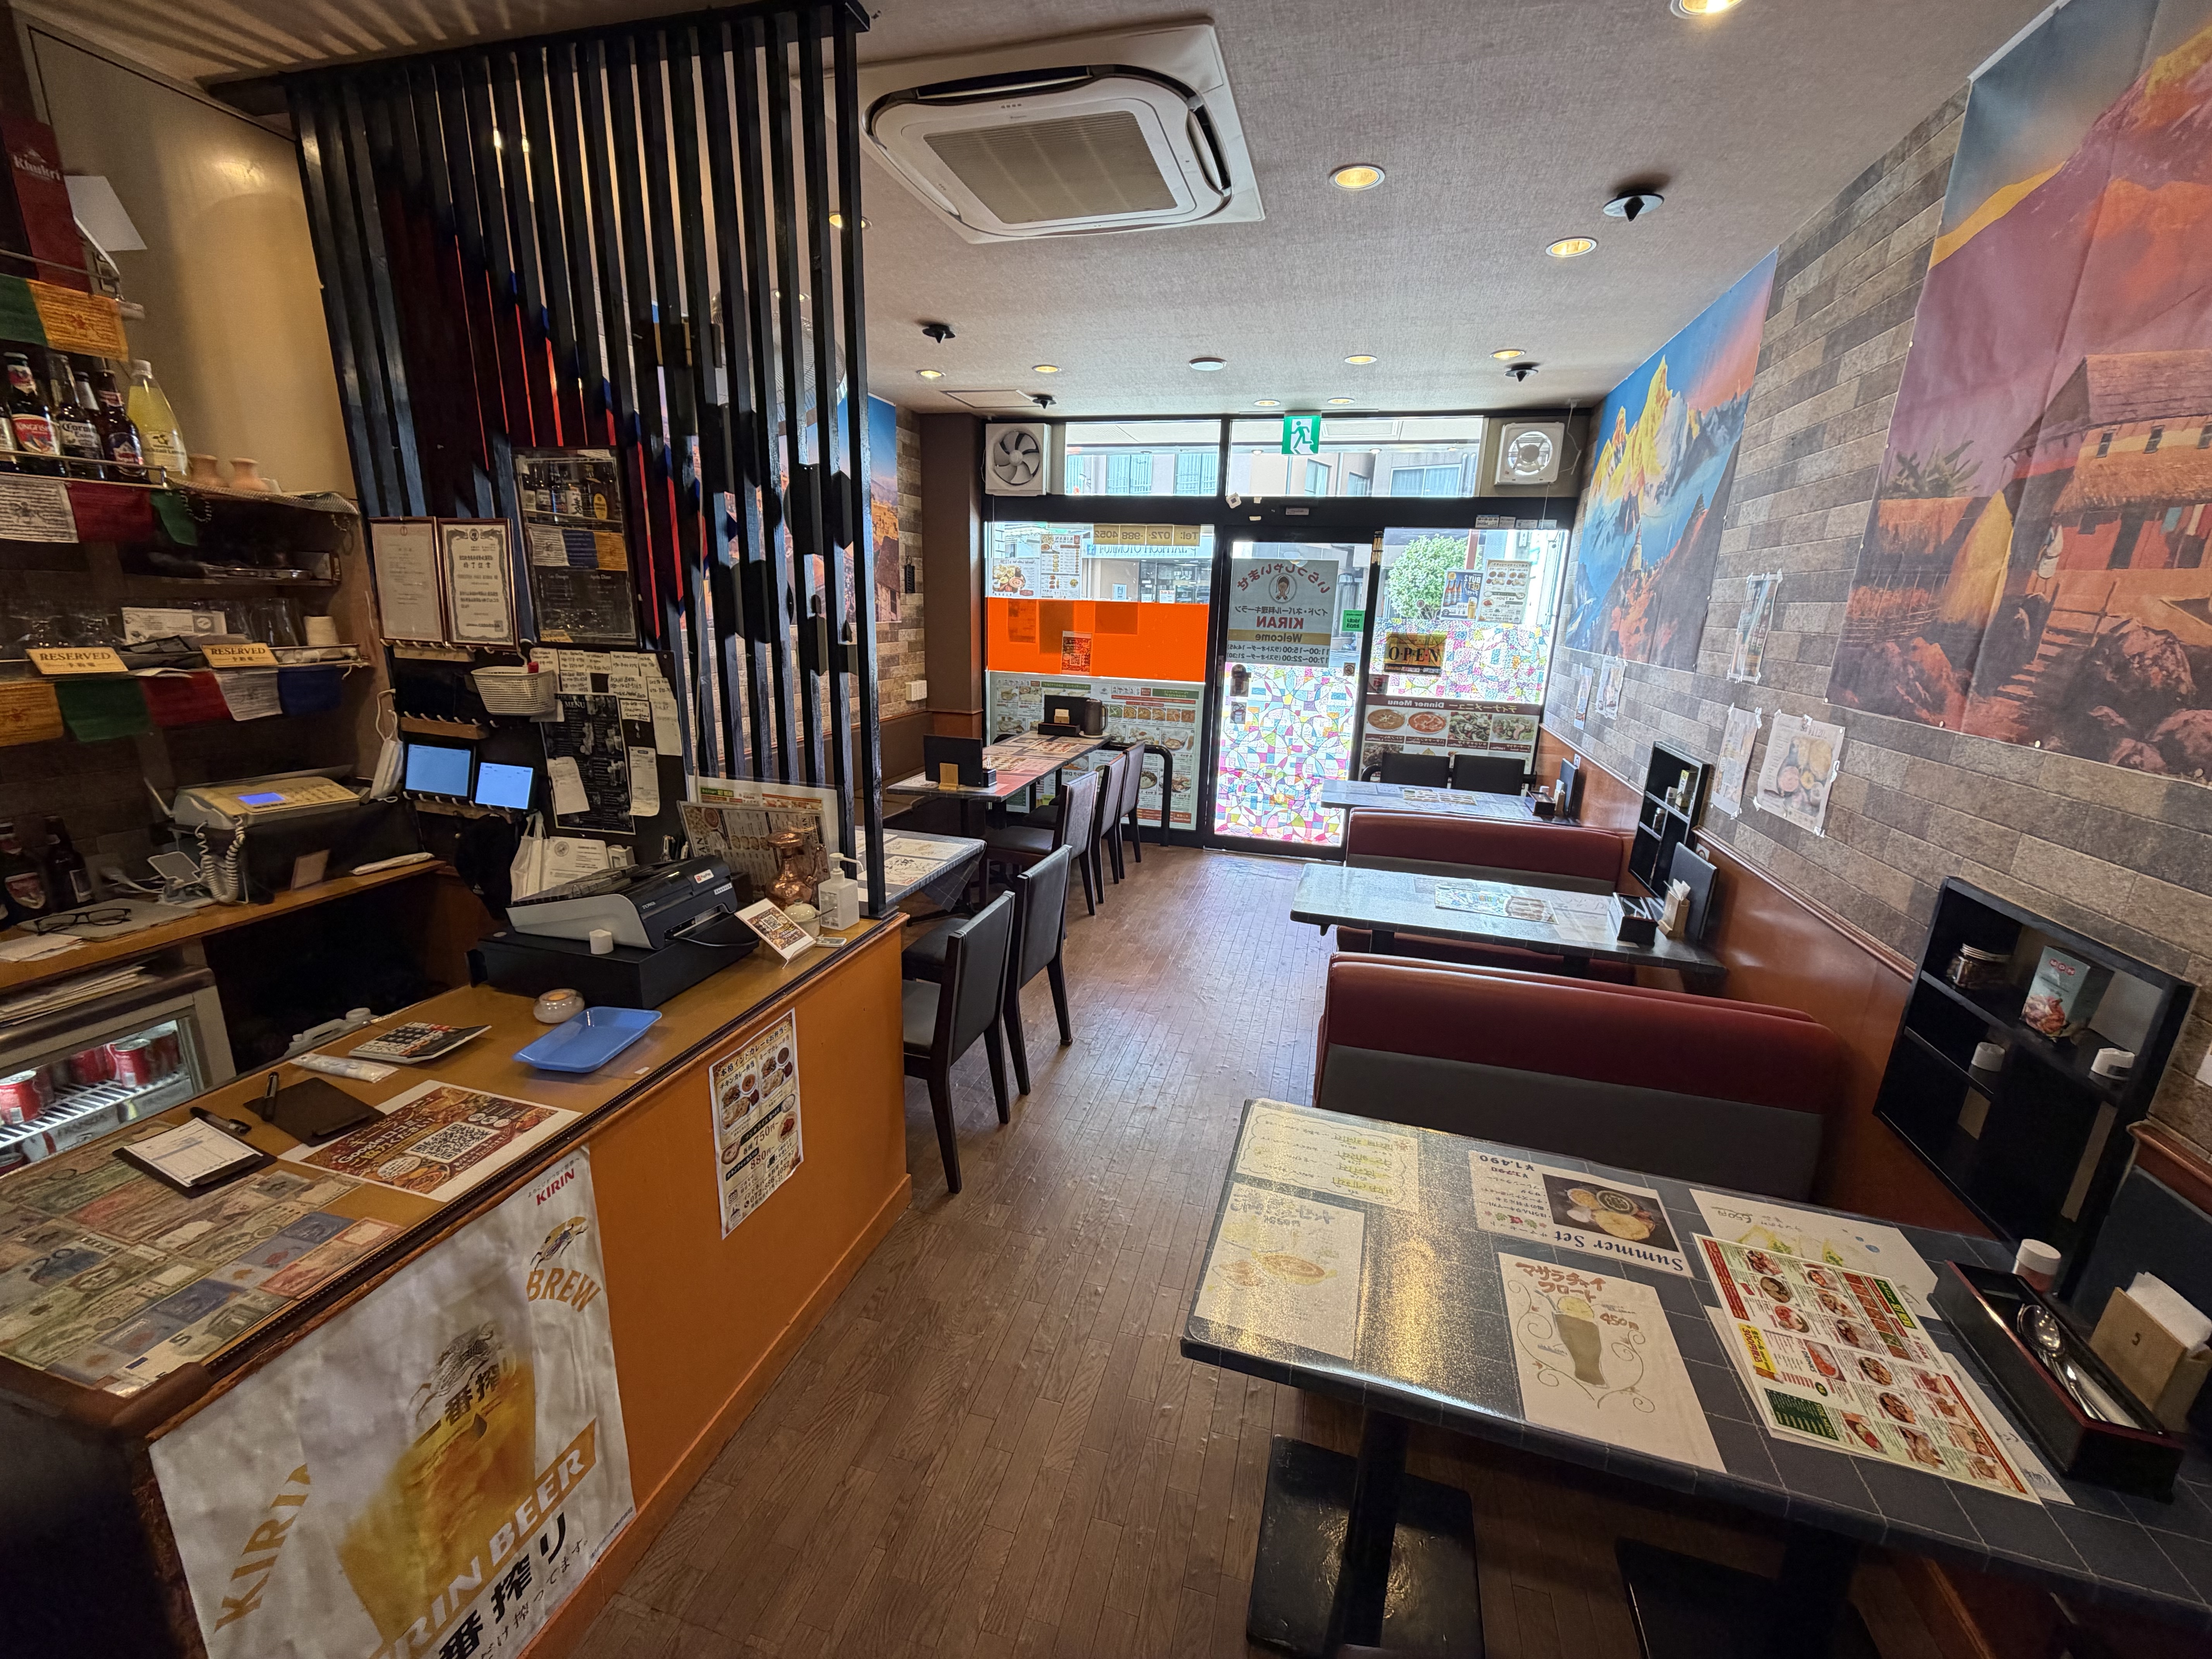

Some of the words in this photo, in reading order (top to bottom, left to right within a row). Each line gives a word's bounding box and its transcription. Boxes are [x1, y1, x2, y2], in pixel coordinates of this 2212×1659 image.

[40, 652, 110, 661] RESERVED
[565, 701, 586, 709] MENU
[720, 1060, 755, 1090] チキンカレー弁当
[536, 1168, 575, 1206] KIRIN
[1552, 1229, 1587, 1249] Set
[1591, 1238, 1686, 1272] Summer
[526, 1267, 601, 1312] BREW
[1515, 1262, 1606, 1291] マサラチャイ
[1538, 1280, 1596, 1302] フロート
[1800, 1350, 1817, 1373] DRINKS
[1912, 1341, 1930, 1360] KIRAN
[1814, 1403, 1827, 1417] SIDE
[1821, 1417, 1836, 1438] MENU
[488, 1447, 585, 1567] BEER
